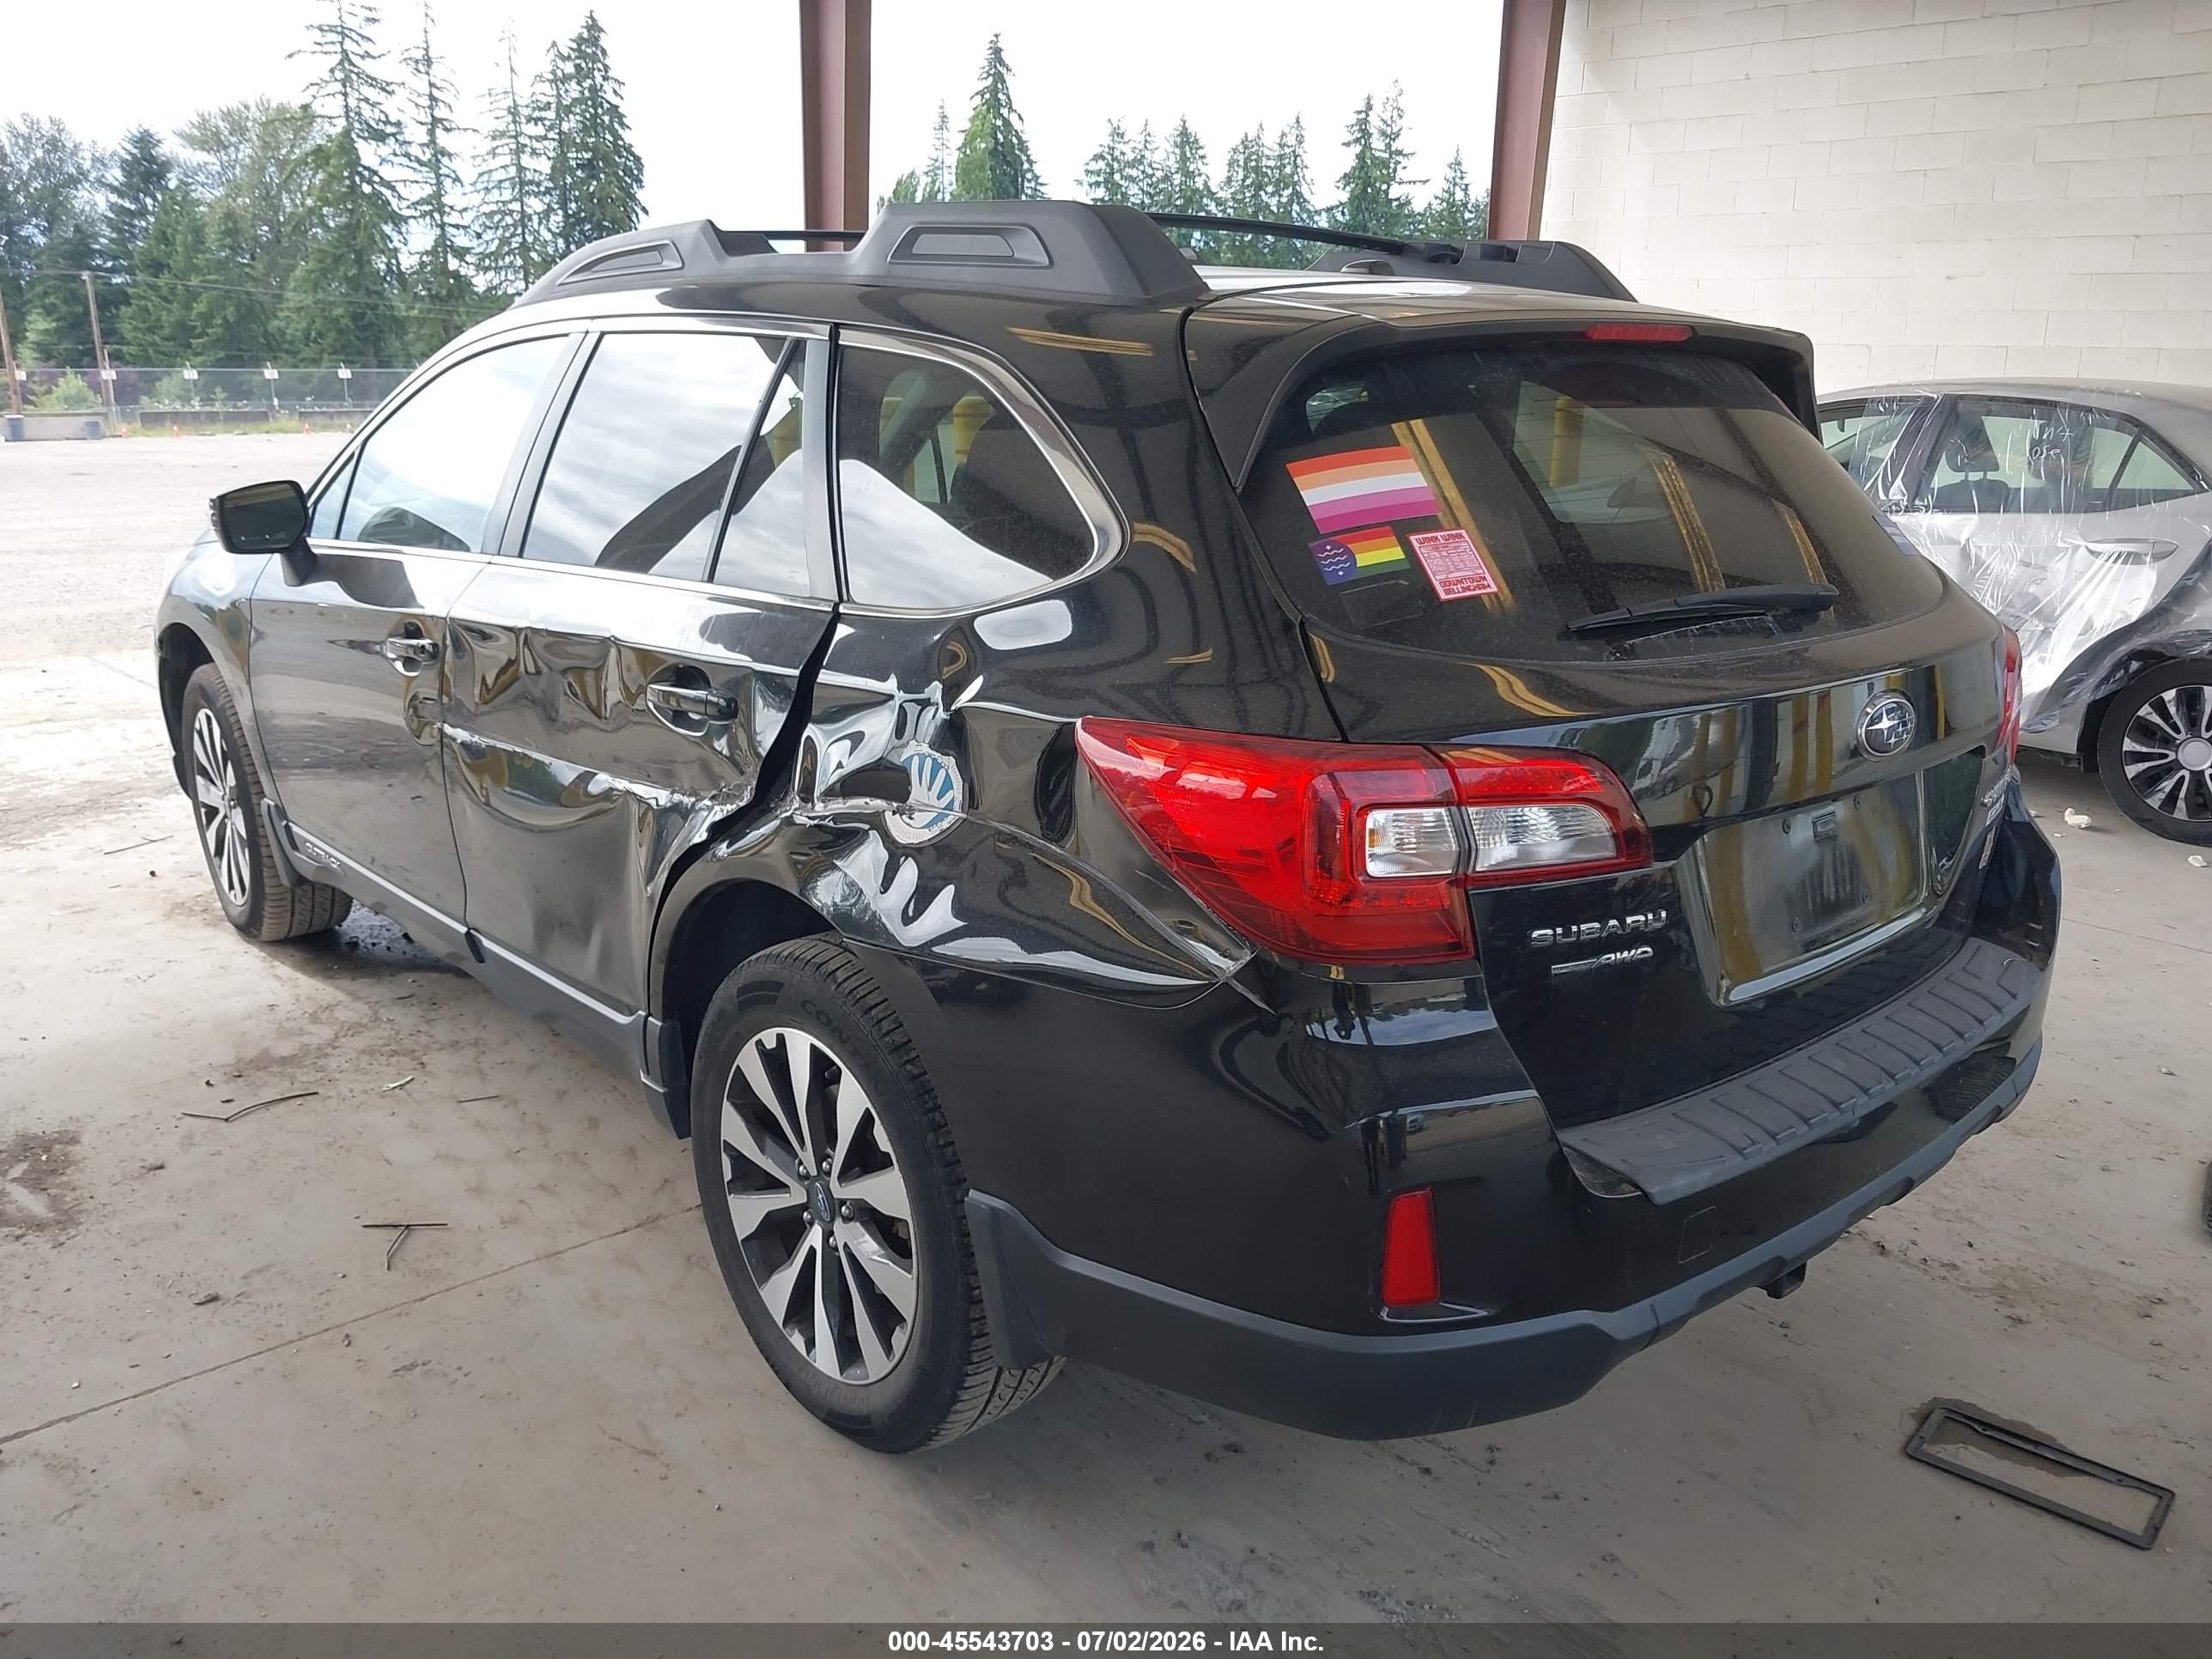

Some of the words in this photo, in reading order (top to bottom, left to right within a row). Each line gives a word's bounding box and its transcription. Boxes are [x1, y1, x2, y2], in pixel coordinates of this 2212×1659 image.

[1415, 535, 1441, 545] WINK
[1440, 532, 1466, 542] WINK
[1438, 575, 1488, 588] DOWNTOWN
[1443, 583, 1492, 596] BELLINGHAM
[1531, 908, 1668, 947] SUBARU
[1590, 945, 1654, 969] AWD
